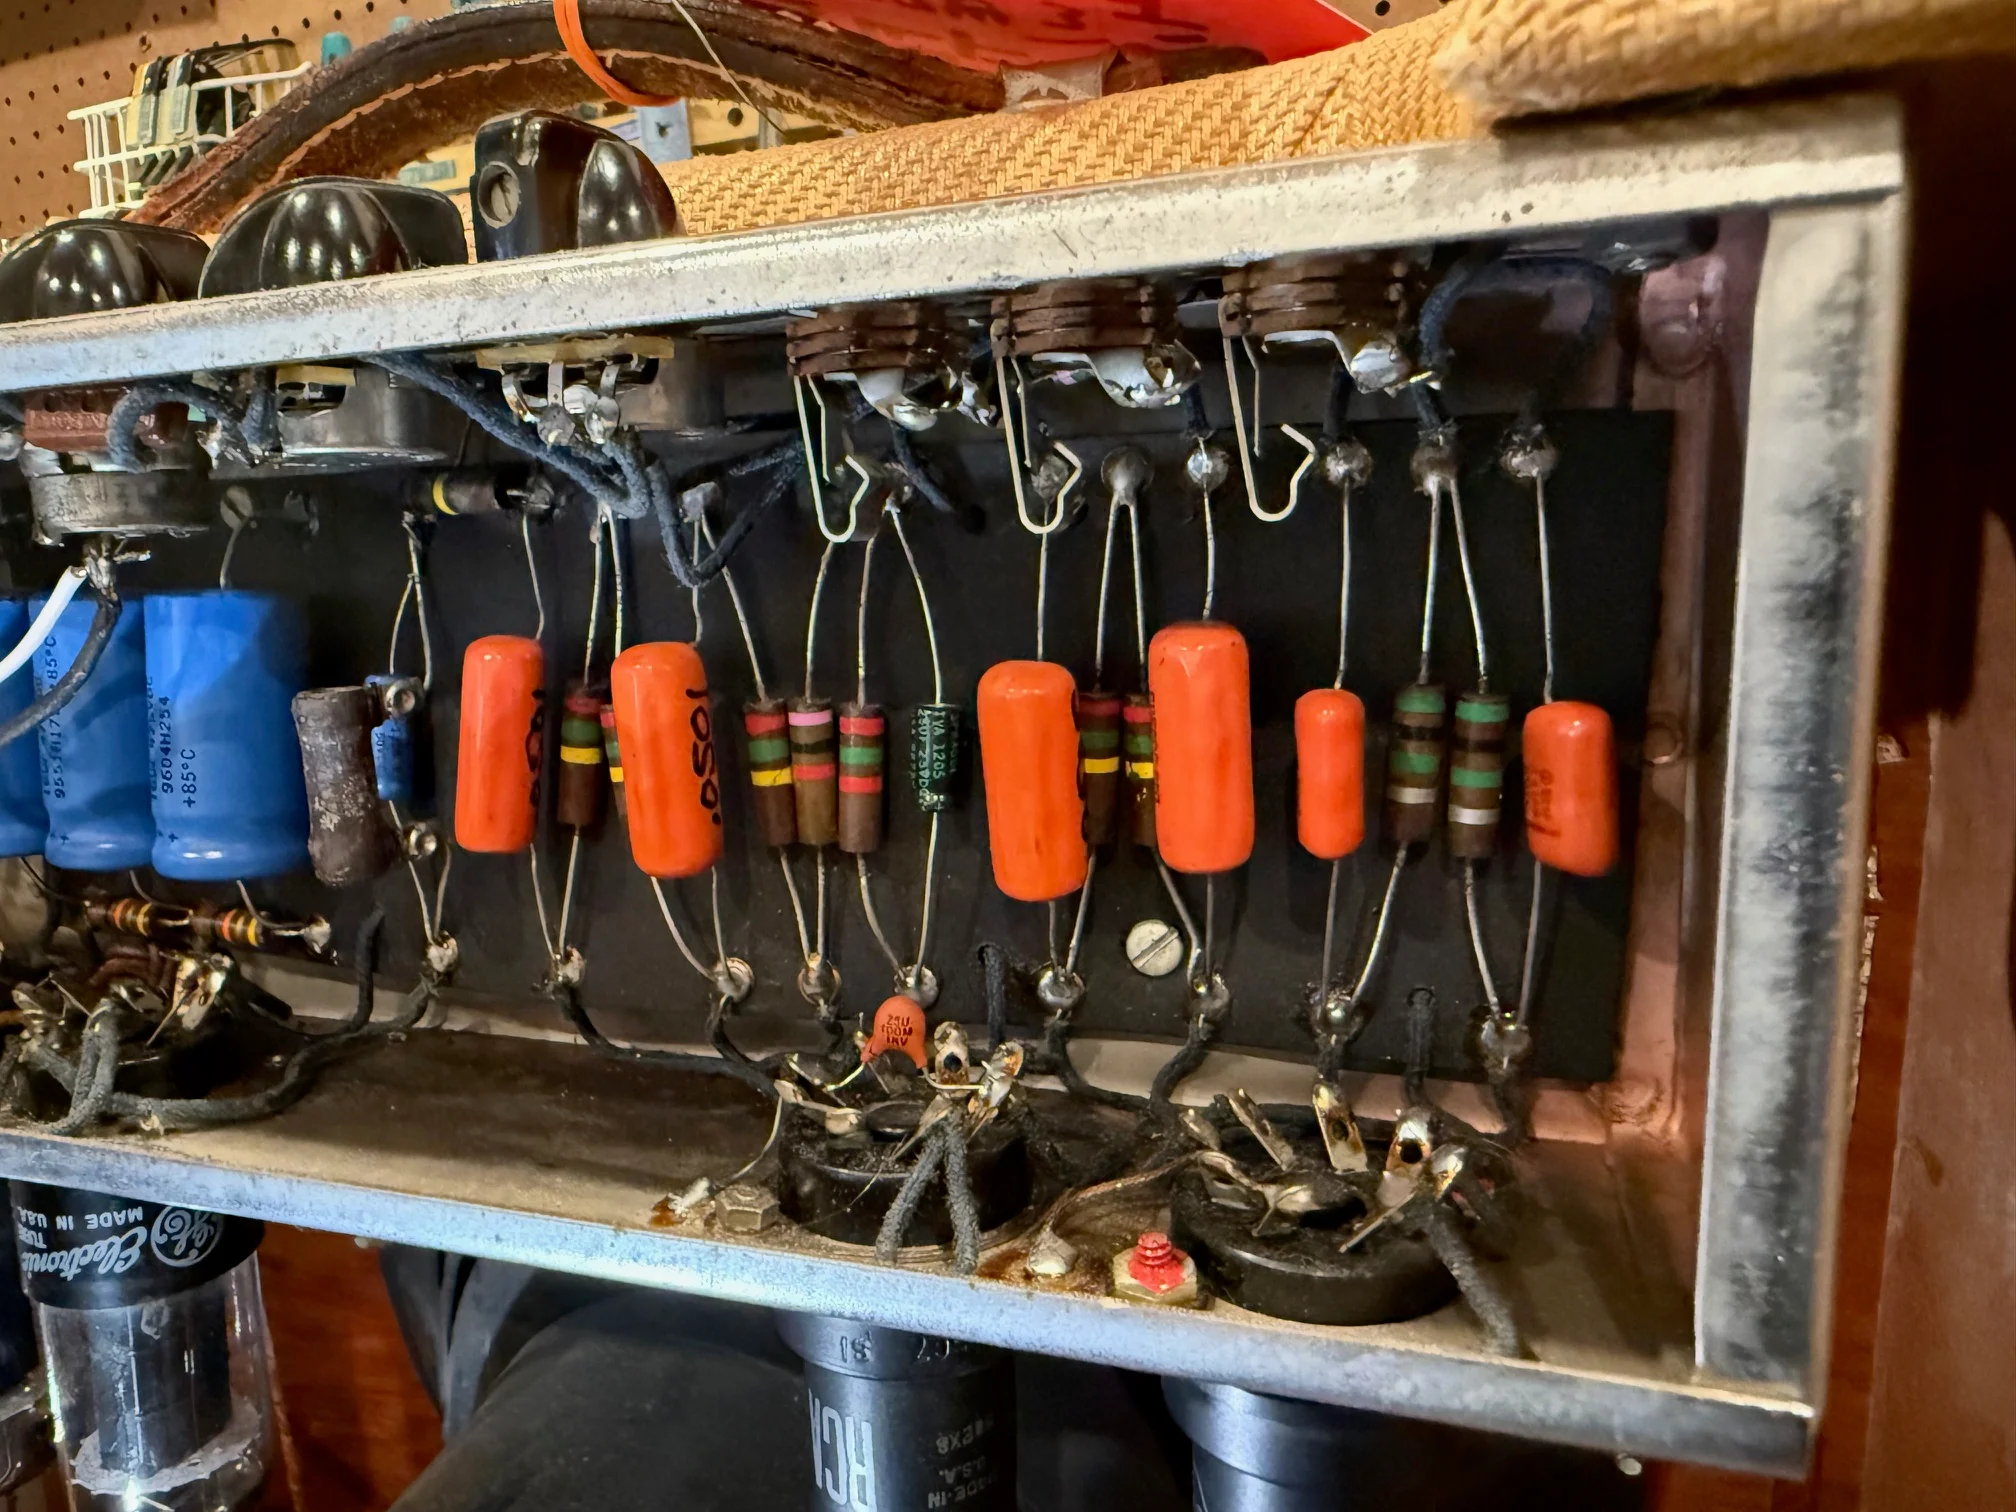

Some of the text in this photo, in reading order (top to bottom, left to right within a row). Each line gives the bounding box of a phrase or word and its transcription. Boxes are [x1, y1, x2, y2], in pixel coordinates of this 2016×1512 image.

[56, 1214, 74, 1231] IN
[85, 1206, 144, 1230] MADE
[808, 1388, 878, 1512] RCA
